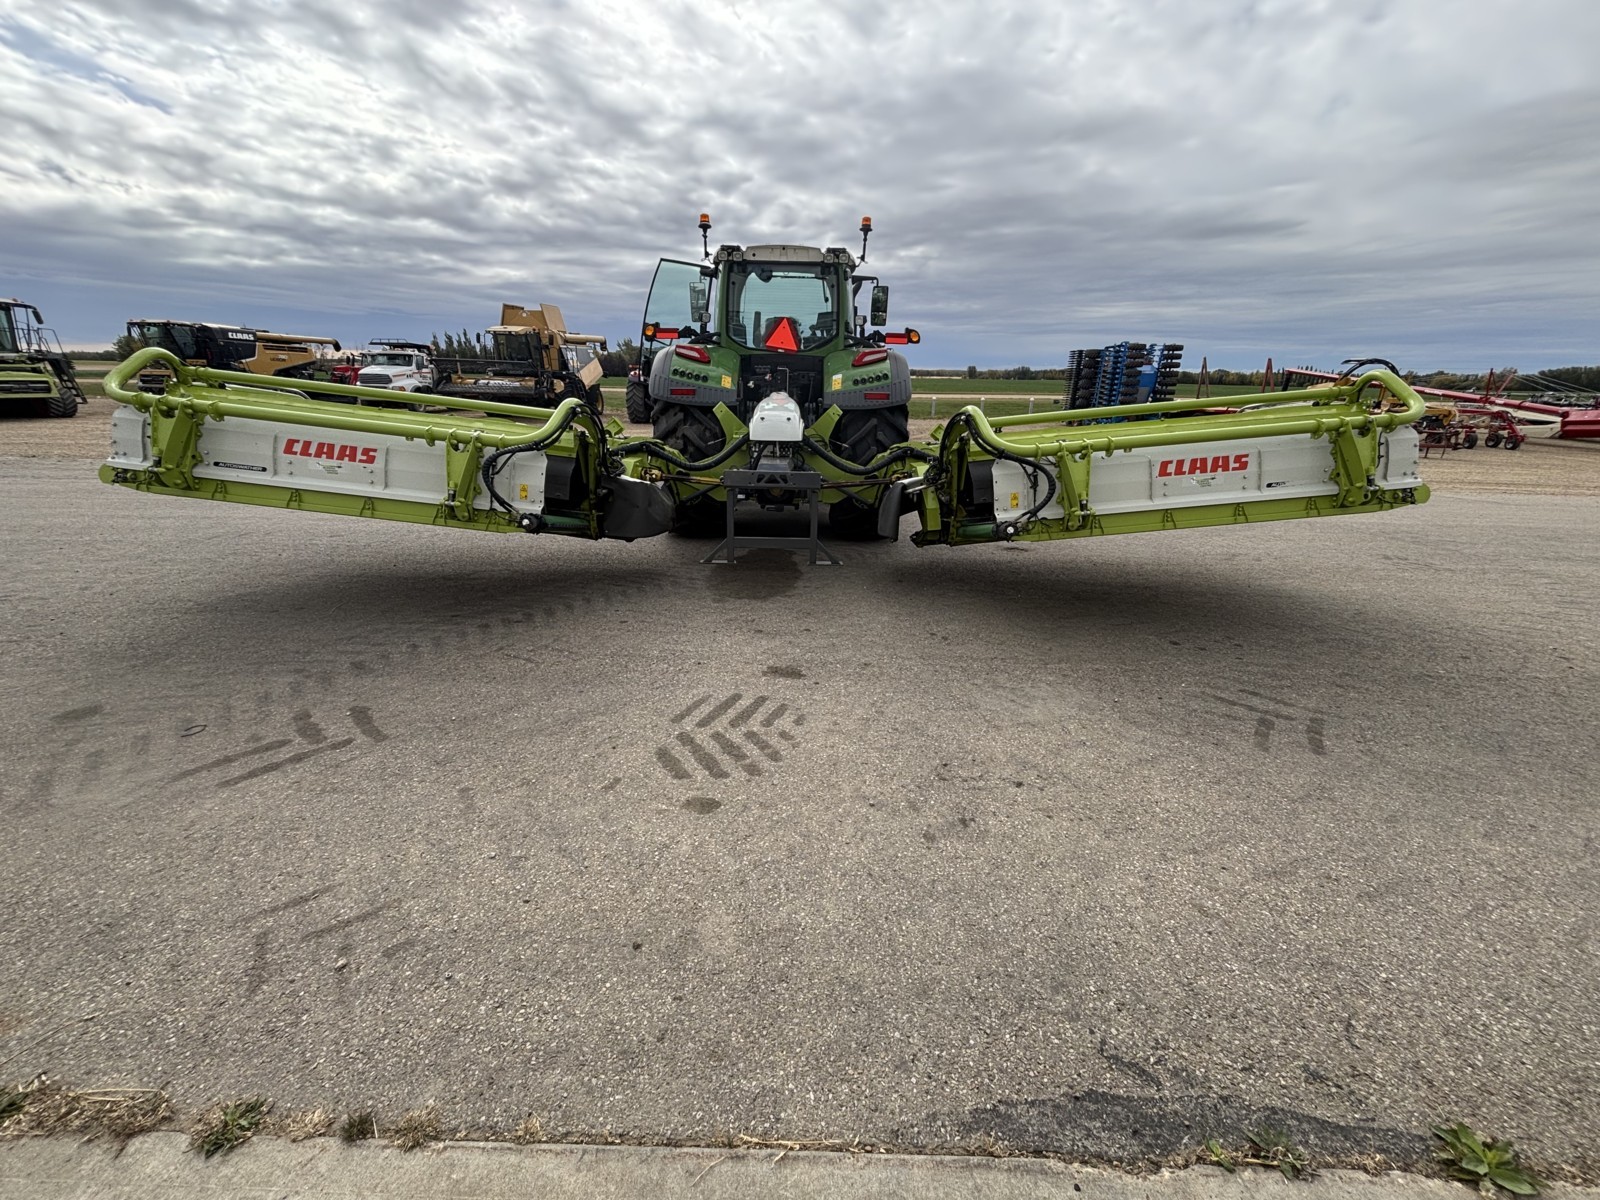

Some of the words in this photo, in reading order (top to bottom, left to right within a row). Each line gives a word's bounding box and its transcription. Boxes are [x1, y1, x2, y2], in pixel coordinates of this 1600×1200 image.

[228, 332, 255, 340] CLAAS
[283, 438, 378, 464] CLAAS
[1157, 453, 1250, 477] CLAAS
